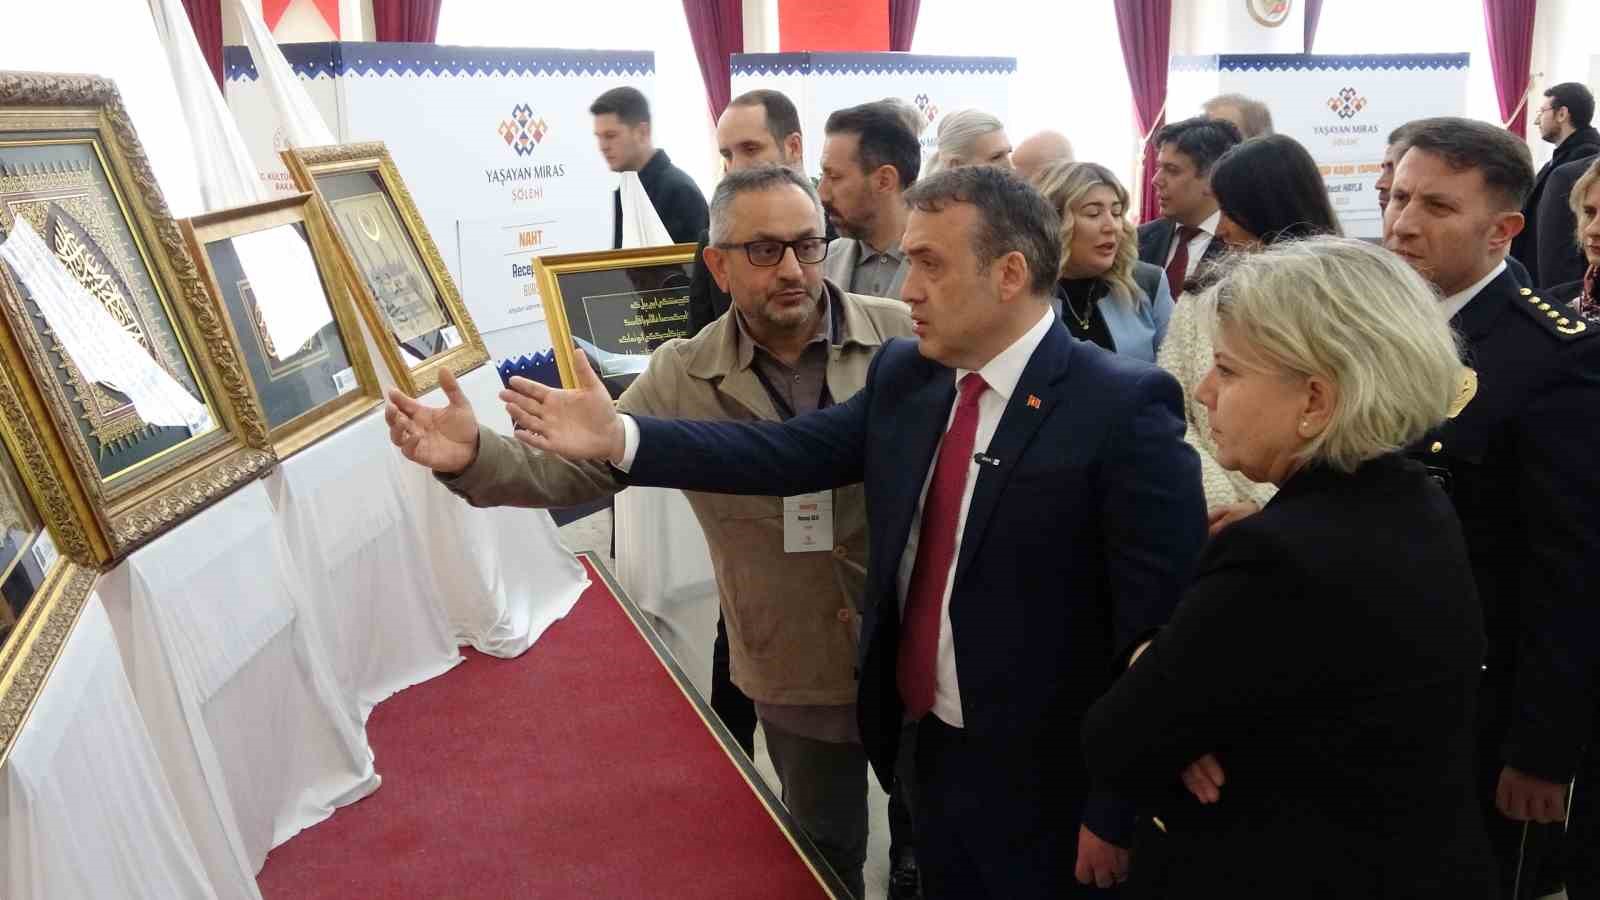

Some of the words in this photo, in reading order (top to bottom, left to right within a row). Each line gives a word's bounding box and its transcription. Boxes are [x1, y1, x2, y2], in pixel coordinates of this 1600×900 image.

[486, 167, 532, 186] YAŞAYAN
[533, 162, 566, 180] MİRAS
[519, 230, 543, 248] NAHT
